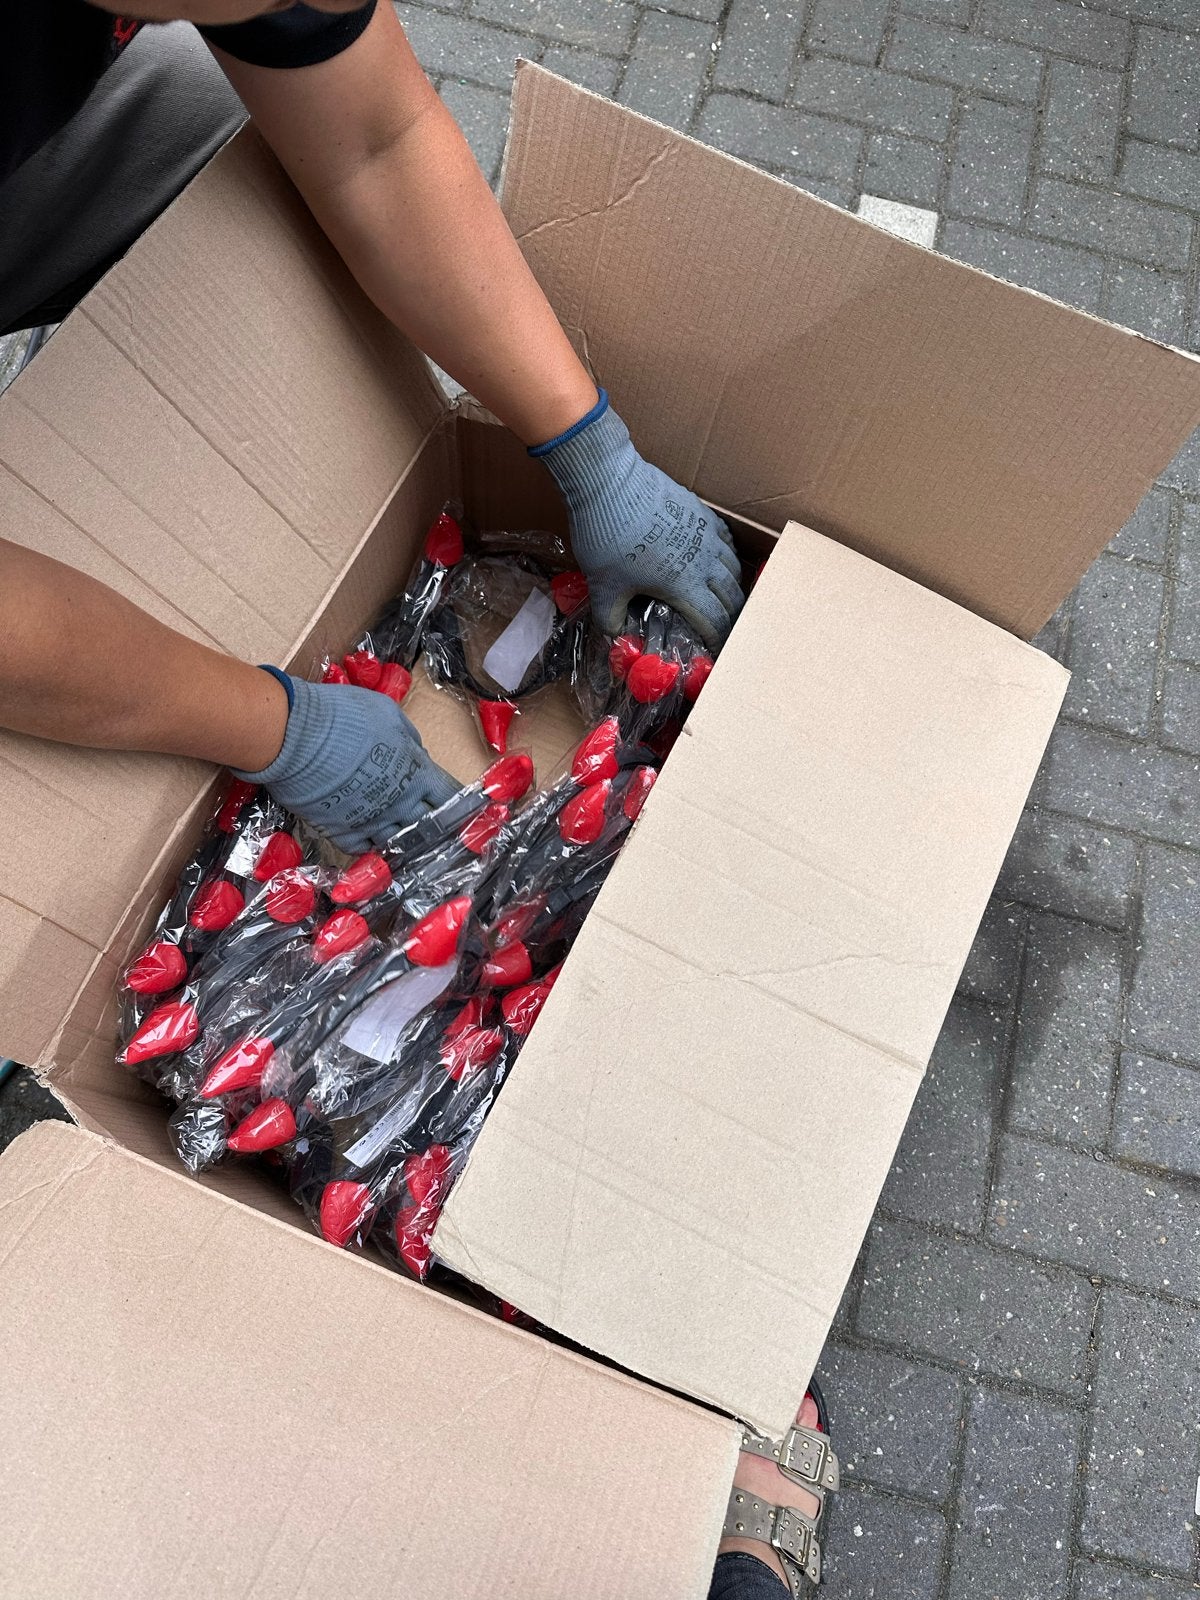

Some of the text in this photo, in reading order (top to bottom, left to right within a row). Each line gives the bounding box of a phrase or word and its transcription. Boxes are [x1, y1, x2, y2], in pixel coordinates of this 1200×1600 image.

[624, 545, 646, 562] CE
[320, 796, 341, 810] CE
[344, 804, 365, 821] GRIP
